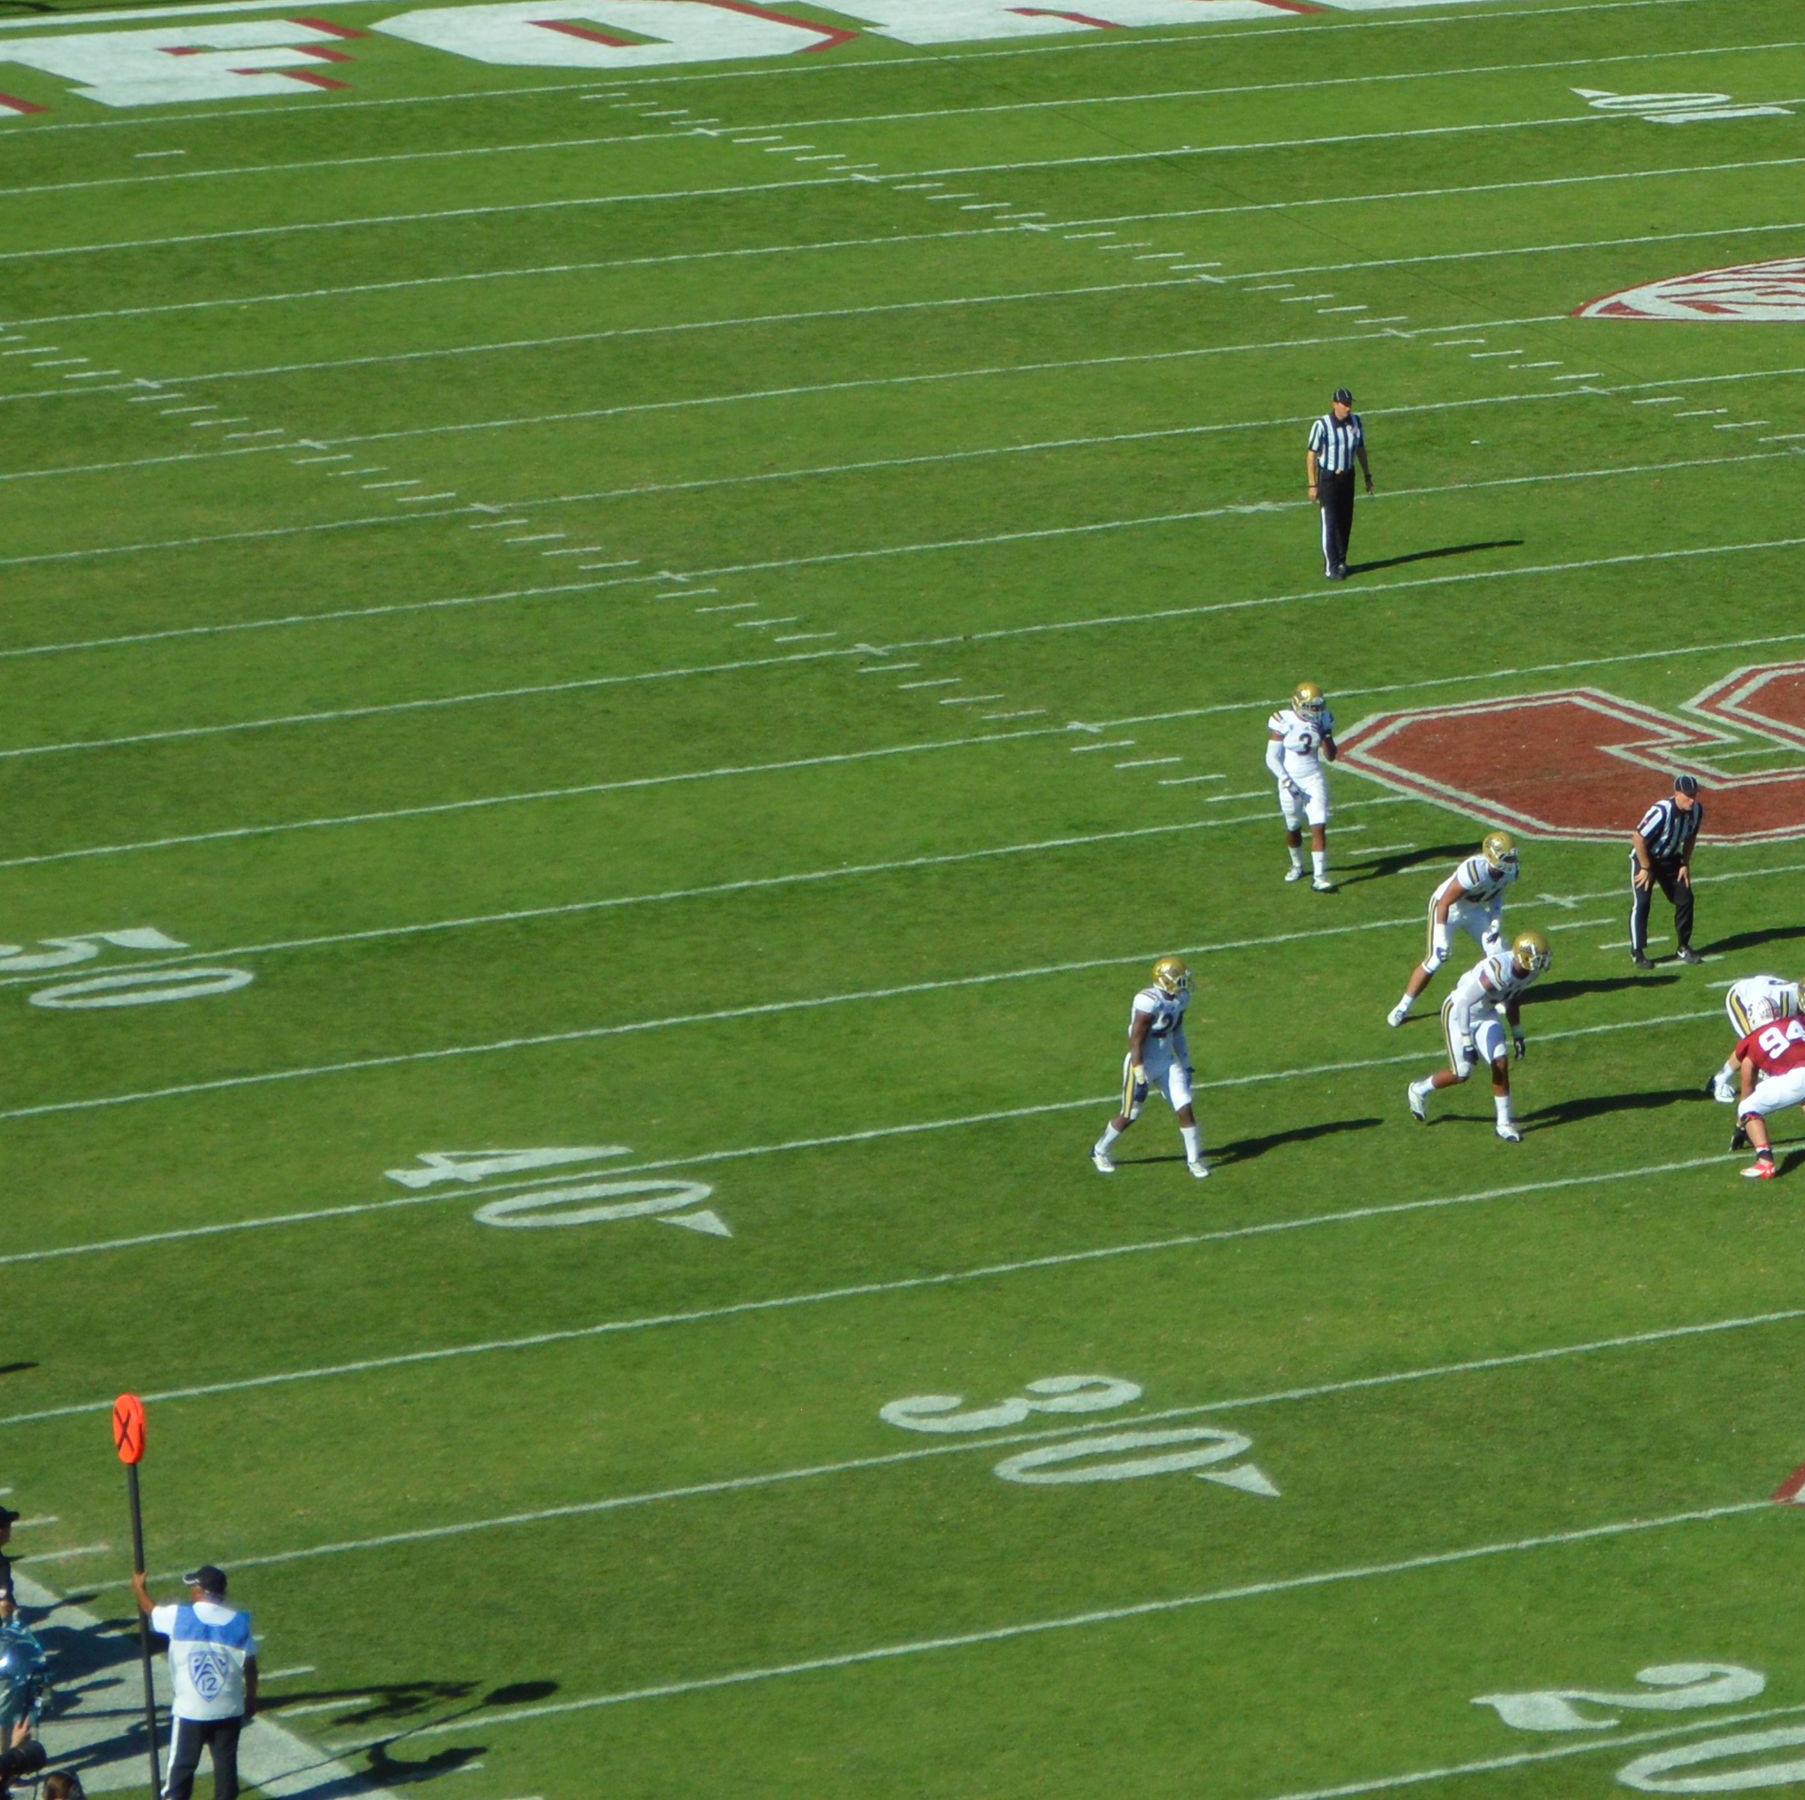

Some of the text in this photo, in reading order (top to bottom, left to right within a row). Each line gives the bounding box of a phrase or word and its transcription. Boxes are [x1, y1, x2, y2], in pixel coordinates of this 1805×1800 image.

[1298, 732, 1313, 756] 3
[384, 1145, 714, 1228] 40
[880, 1374, 1253, 1485] 30
[201, 1677, 218, 1693] 12
